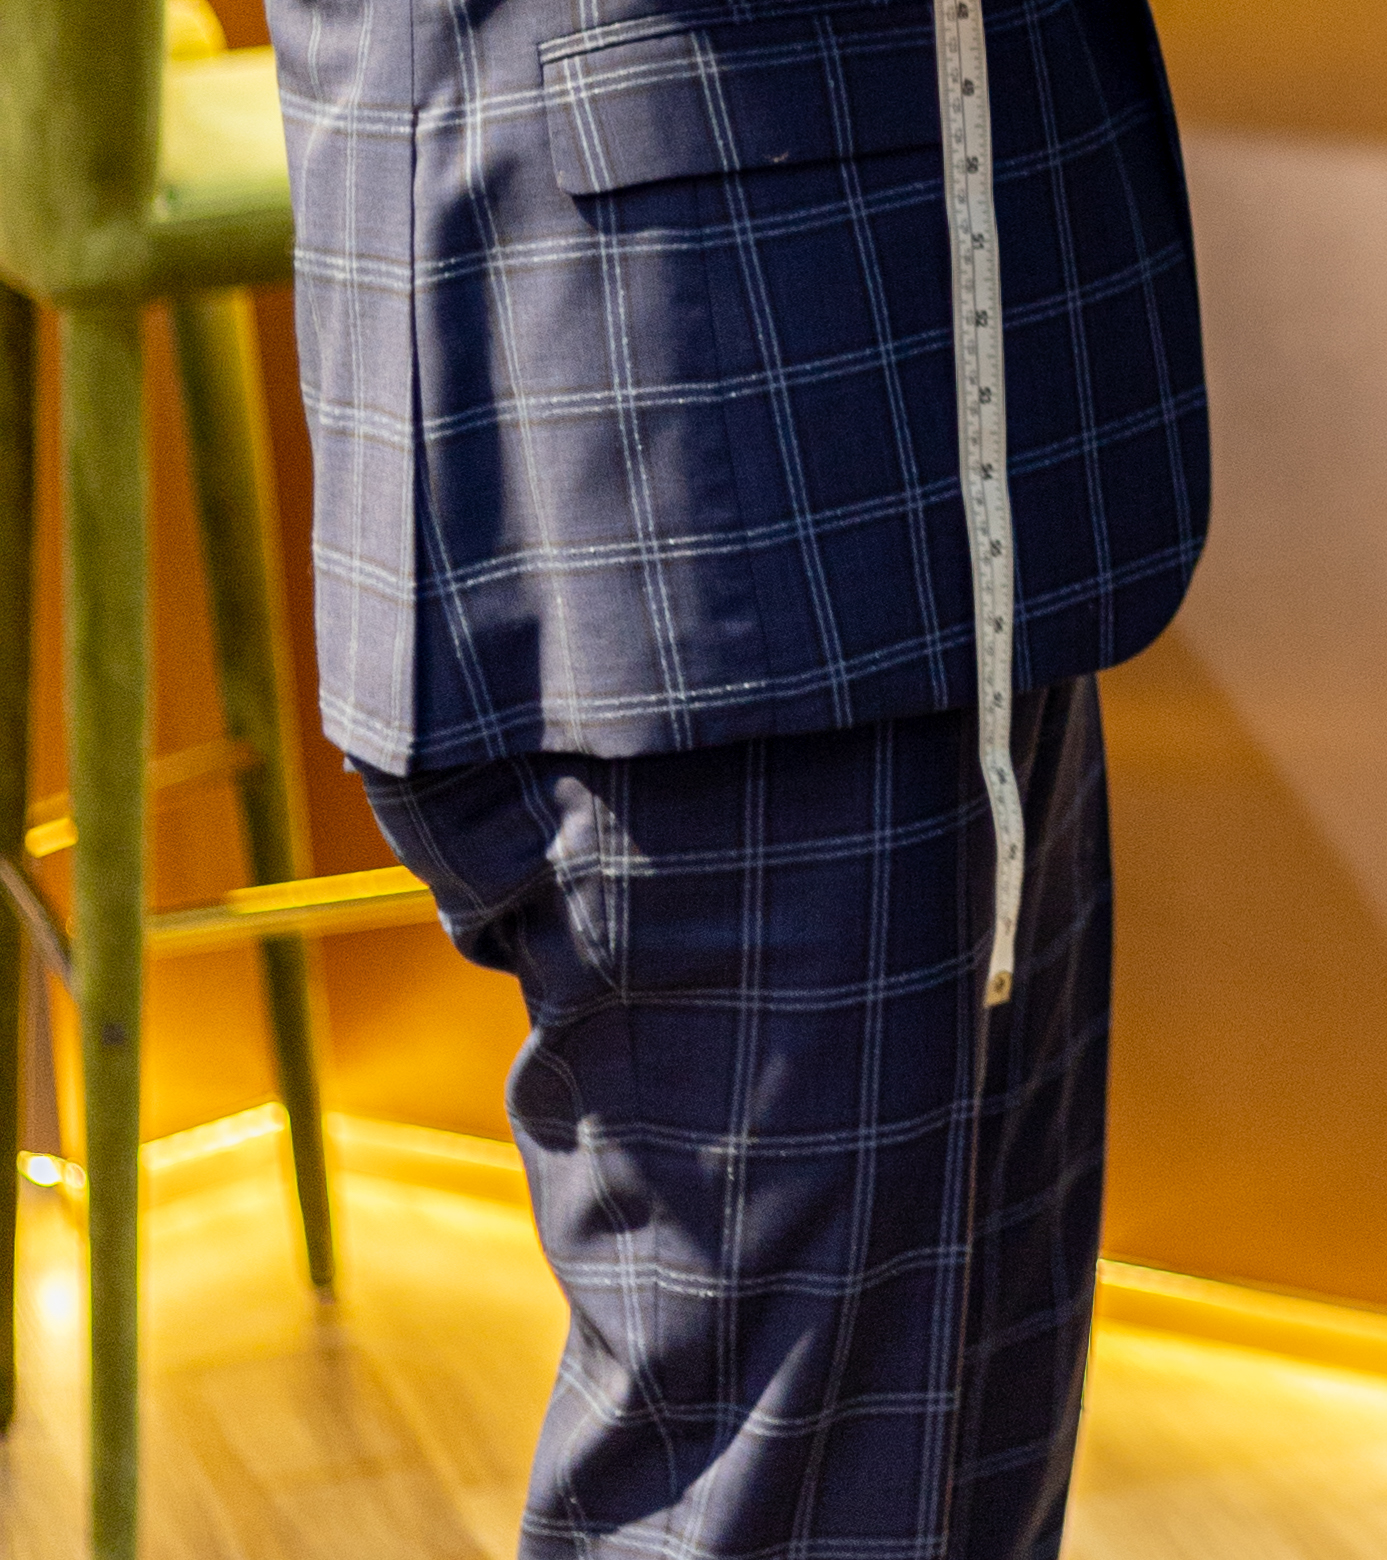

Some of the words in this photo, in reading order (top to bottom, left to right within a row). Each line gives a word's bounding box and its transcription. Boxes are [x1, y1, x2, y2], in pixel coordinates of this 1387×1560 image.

[971, 233, 984, 250] 51
[975, 310, 988, 327] 52
[979, 386, 992, 404] 53
